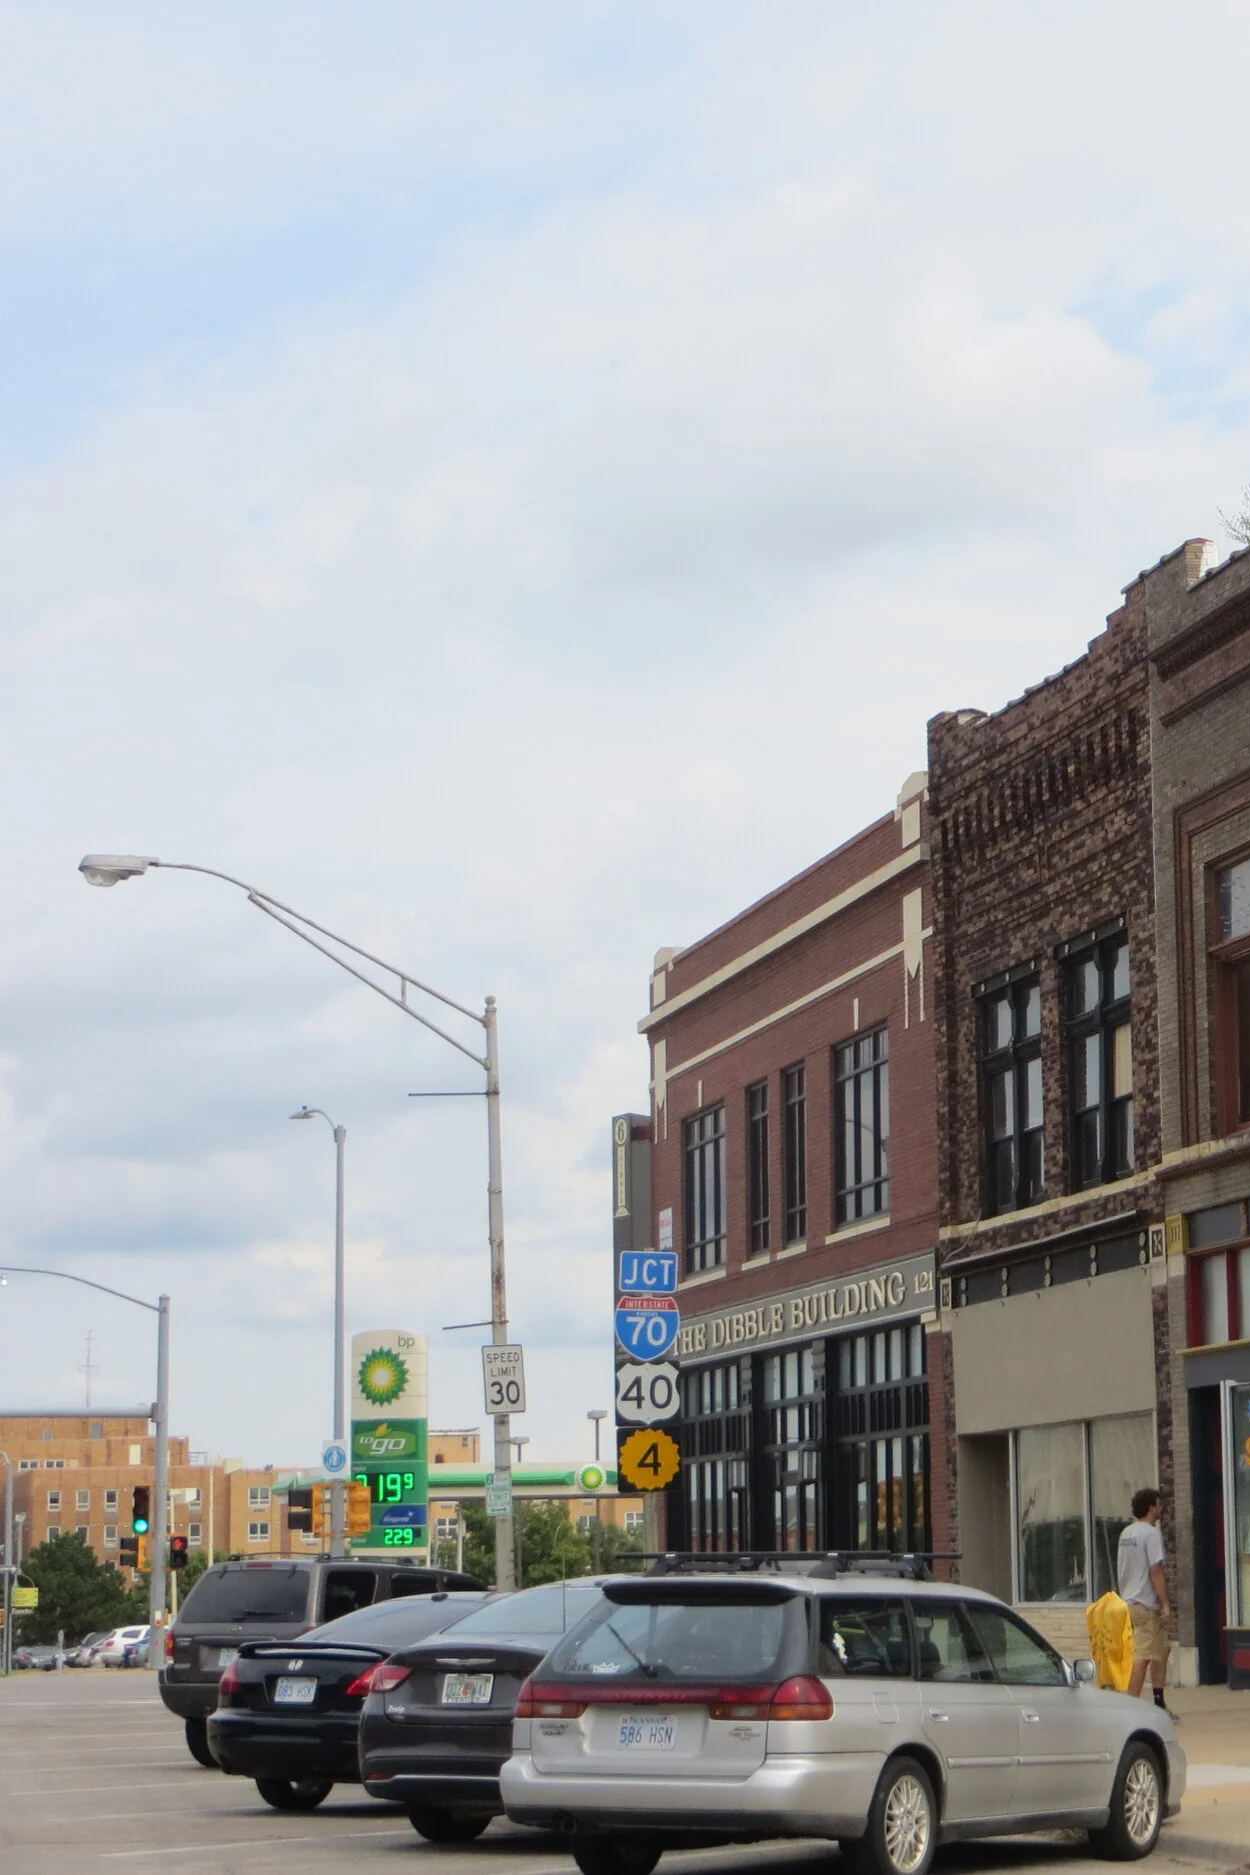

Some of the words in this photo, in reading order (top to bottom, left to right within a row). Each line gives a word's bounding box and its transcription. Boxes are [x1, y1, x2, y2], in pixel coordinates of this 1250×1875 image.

[624, 1258, 674, 1286] JCT
[625, 1300, 671, 1310] INTERSTATE
[673, 1324, 707, 1357] THE
[711, 1303, 785, 1347] DIBBLE
[789, 1271, 907, 1329] BUILDING
[914, 1270, 934, 1295] 121
[626, 1315, 668, 1347] 70
[397, 1335, 416, 1349] bp
[486, 1352, 520, 1363] SPEED
[490, 1366, 517, 1377] LIMIT
[490, 1380, 520, 1405] 30
[620, 1374, 673, 1410] 40
[370, 1437, 406, 1455] go
[637, 1442, 662, 1476] 4
[384, 1528, 413, 1545] 229
[620, 1726, 642, 1744] 586
[649, 1726, 674, 1744] HSN
